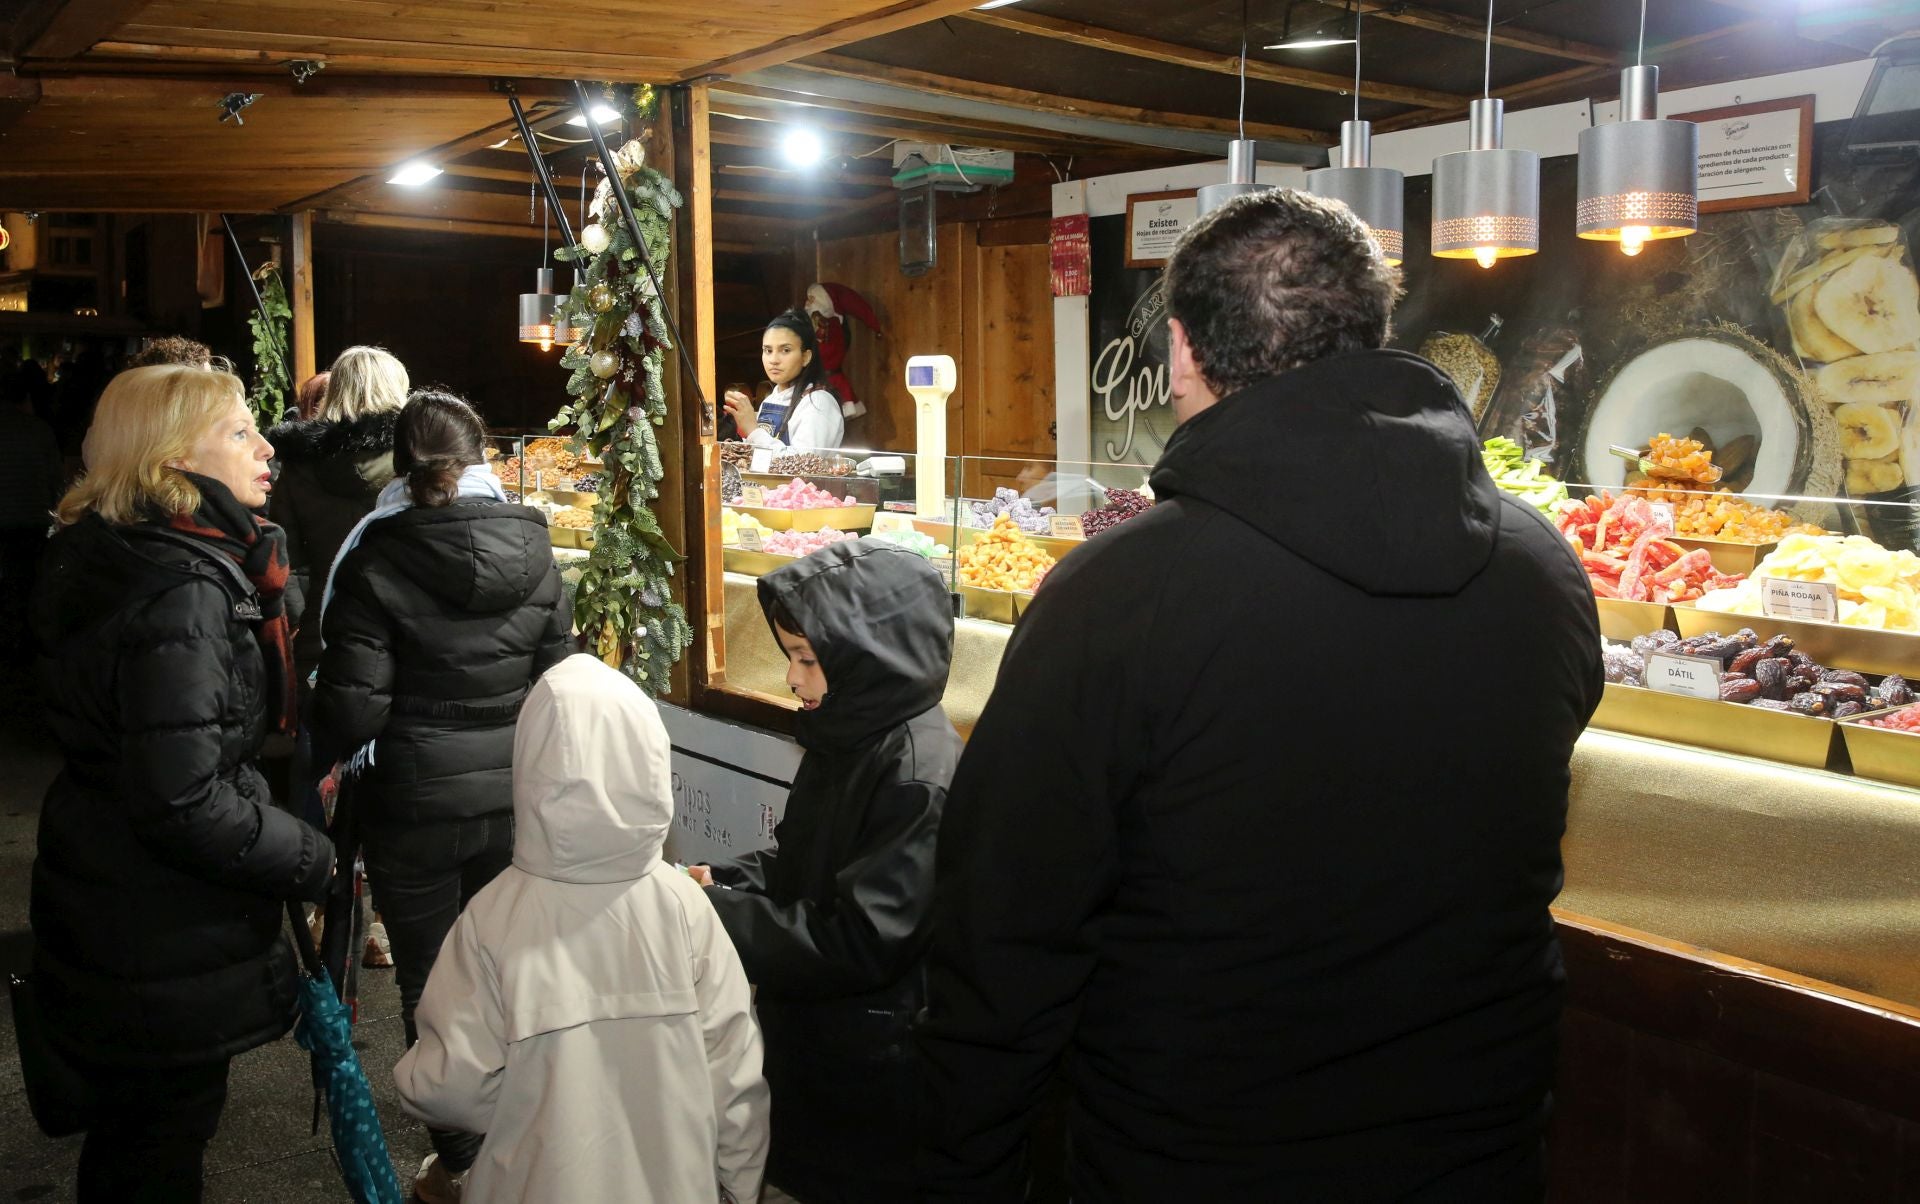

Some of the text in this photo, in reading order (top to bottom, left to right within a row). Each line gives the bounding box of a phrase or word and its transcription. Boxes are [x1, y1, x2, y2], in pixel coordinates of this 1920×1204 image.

[1698, 152, 1722, 160] onemos
[1732, 147, 1751, 156] fichas
[1758, 153, 1789, 163] producto
[1724, 167, 1733, 175] de
[1149, 218, 1178, 228] Existen
[1136, 229, 1151, 237] Hojas
[1151, 228, 1158, 236] de
[1771, 588, 1822, 601] PIÑA RODAJA
[1668, 668, 1695, 680] DÁTIL
